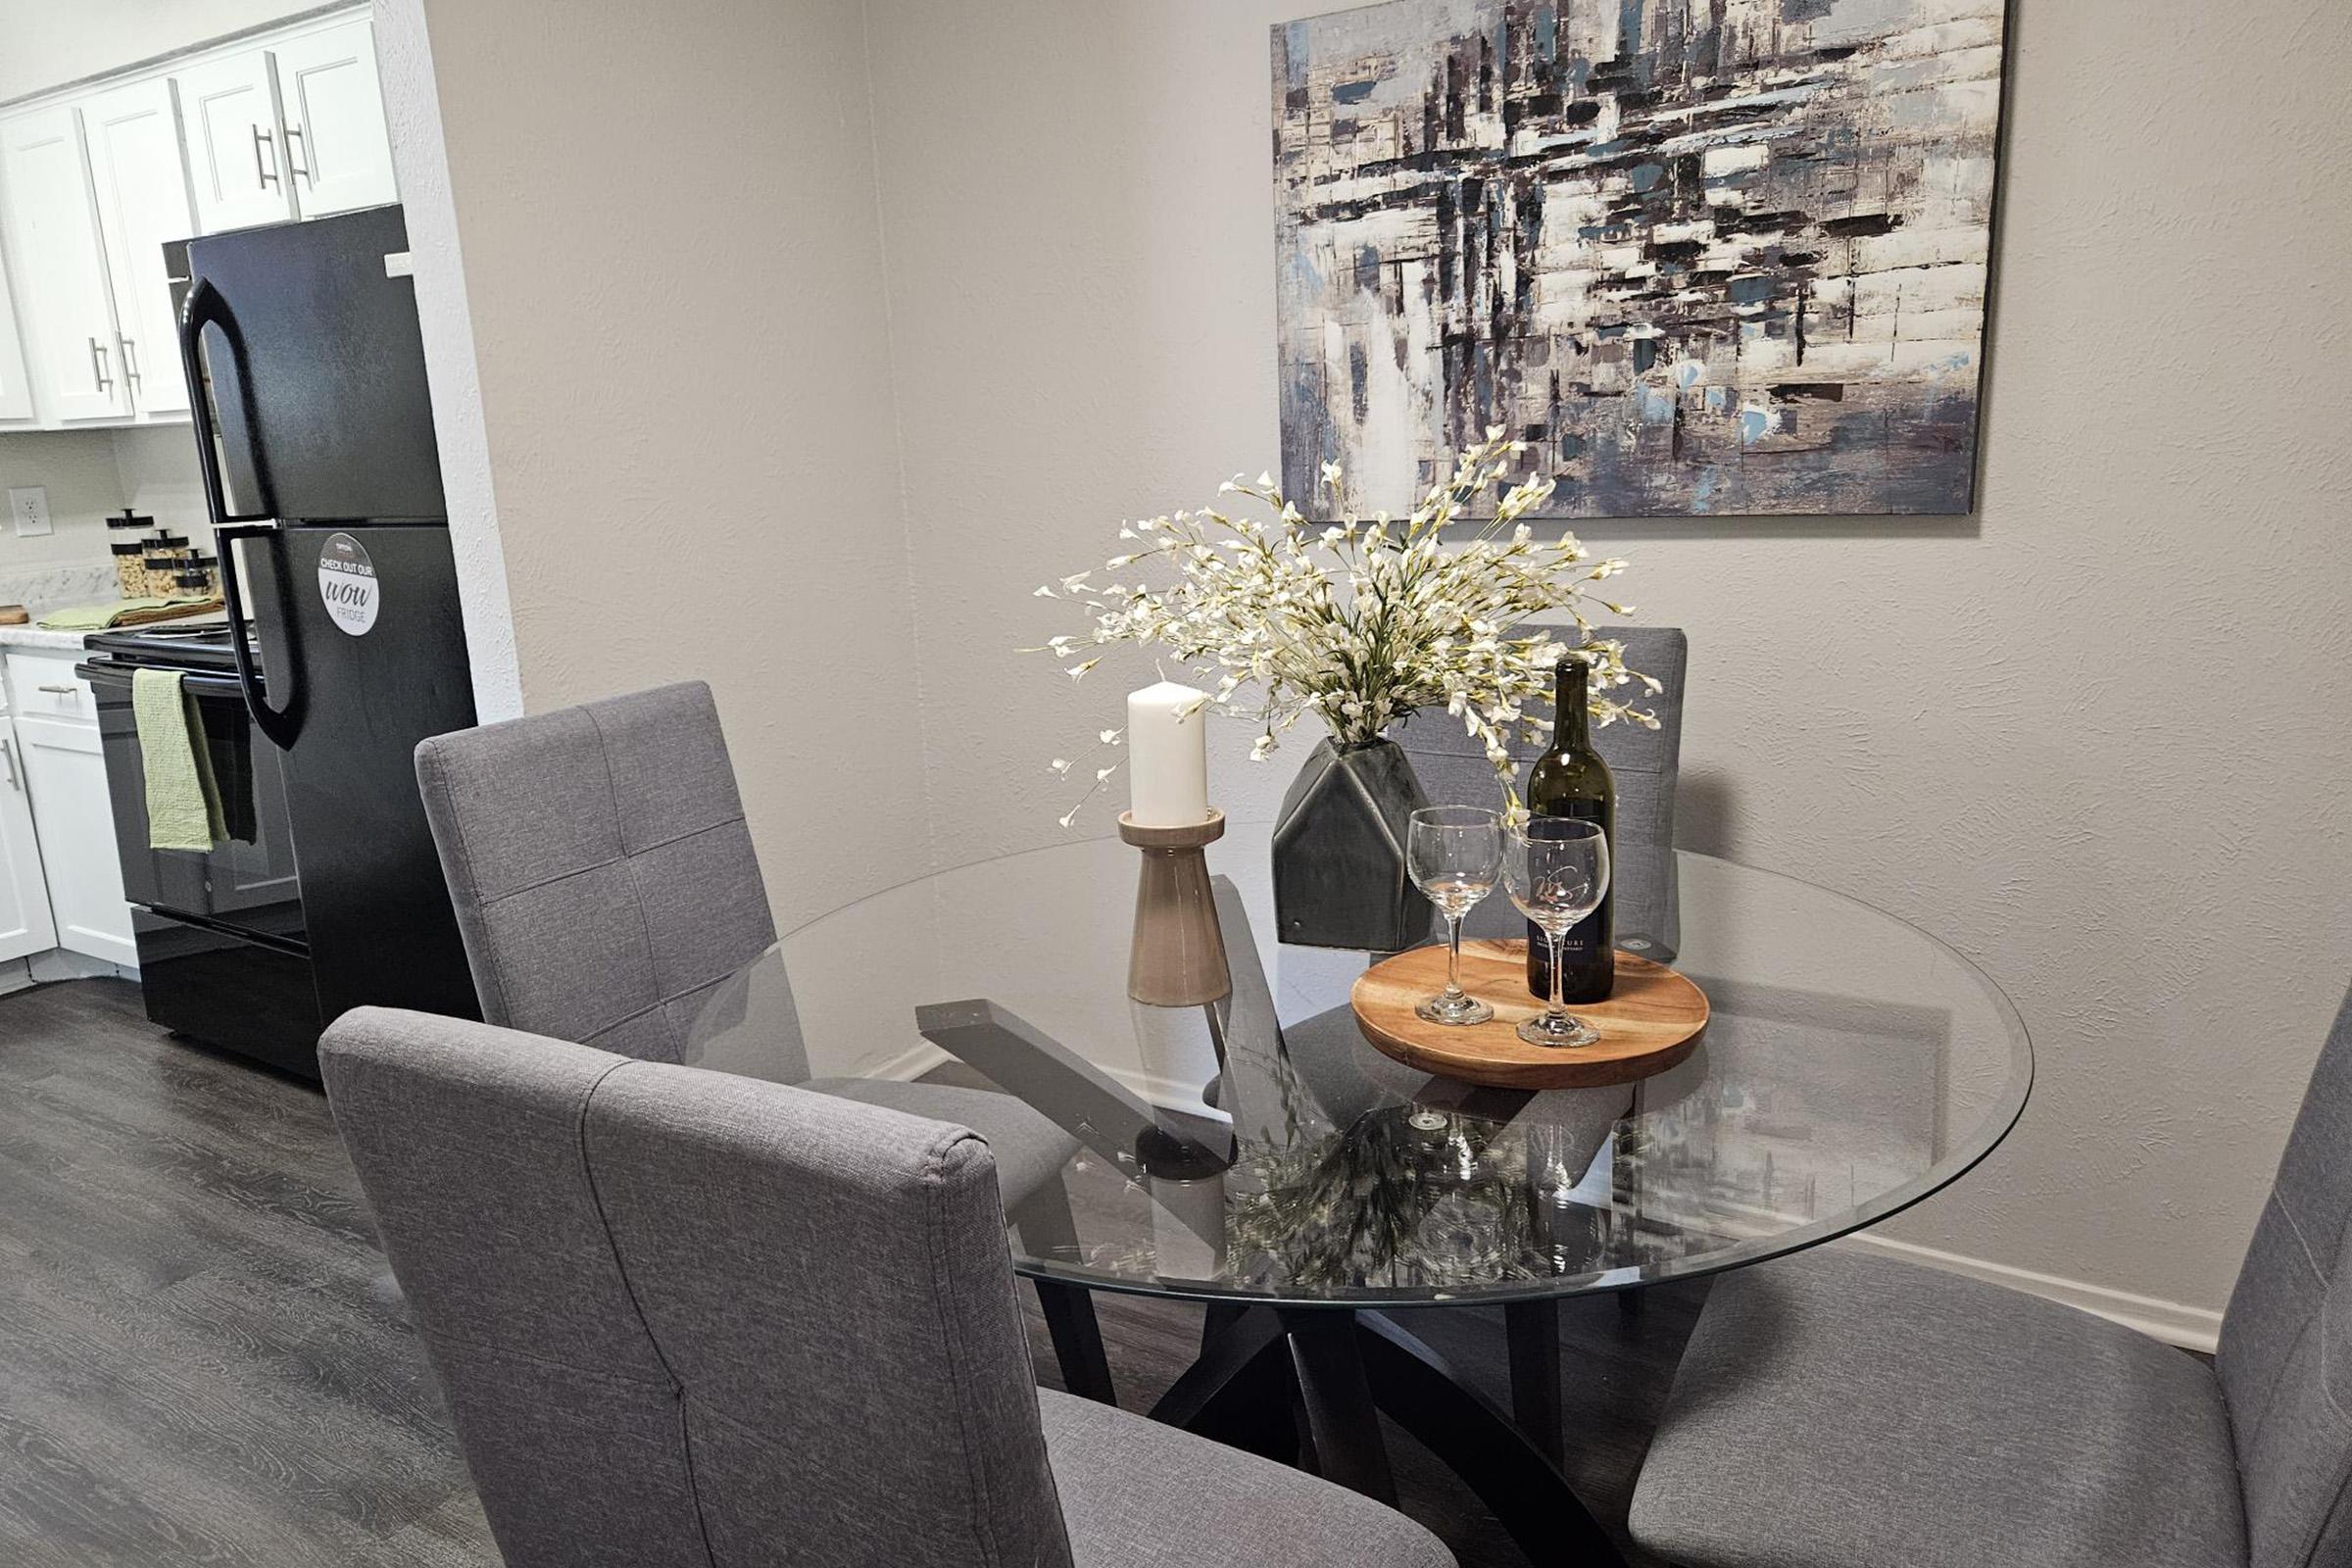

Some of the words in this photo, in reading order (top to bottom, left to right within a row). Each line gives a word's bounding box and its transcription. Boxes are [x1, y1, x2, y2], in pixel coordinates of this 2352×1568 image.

[320, 558, 343, 569] CHECK
[343, 562, 357, 572] OUT
[358, 564, 372, 576] OUR
[337, 608, 366, 622] FRIDGE
